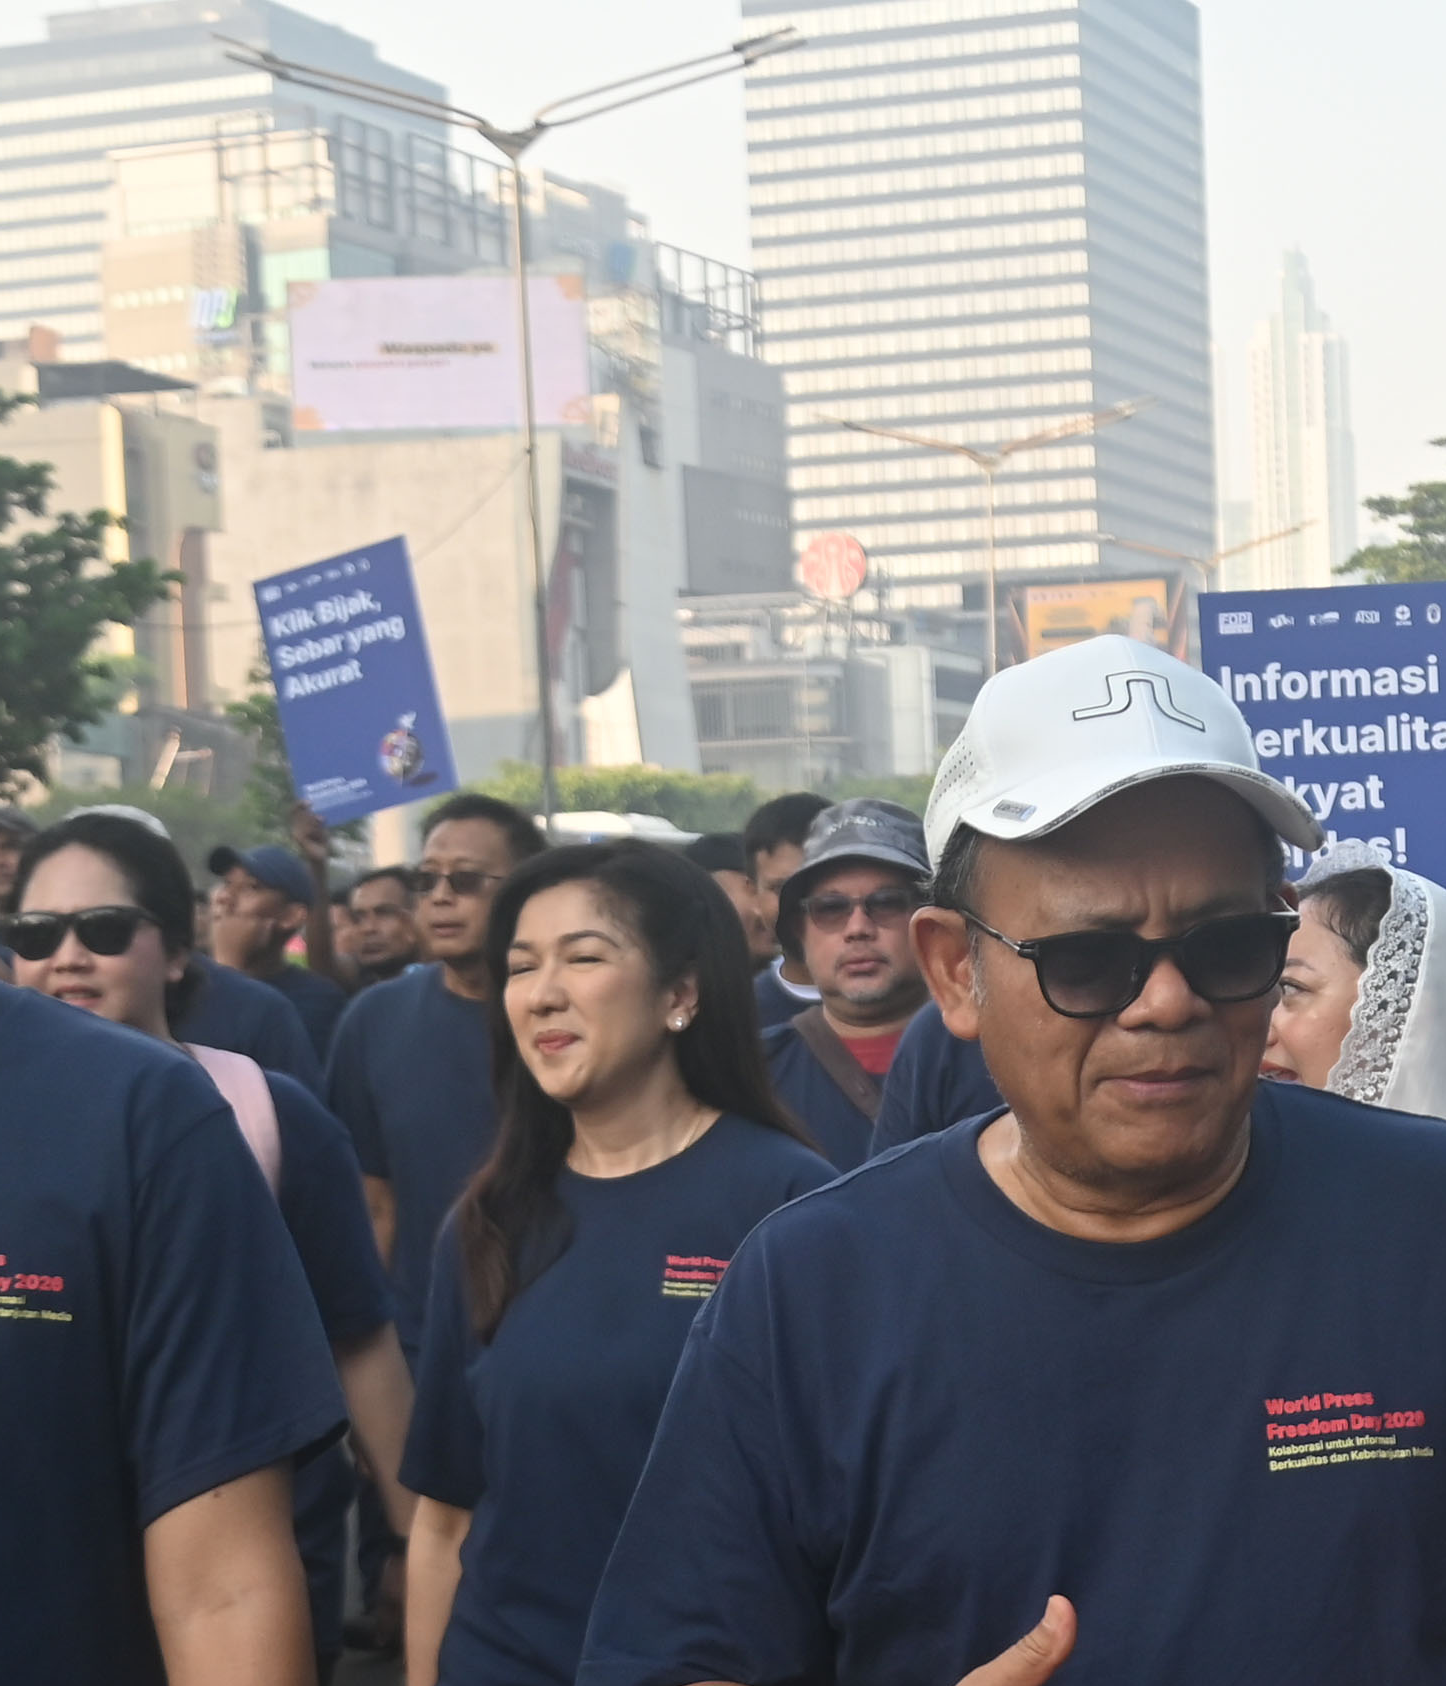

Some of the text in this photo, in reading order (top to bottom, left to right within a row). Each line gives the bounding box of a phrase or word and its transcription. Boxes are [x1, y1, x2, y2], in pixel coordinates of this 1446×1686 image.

[269, 607, 317, 638] Klik
[315, 589, 382, 623] Bijak,
[276, 615, 406, 669] Sebar yang
[285, 659, 364, 699] Akurat
[1220, 654, 1439, 702] Informasi
[1284, 774, 1386, 821] kyat
[1265, 1391, 1374, 1416] World Press
[1266, 1417, 1349, 1440] Freedom
[1350, 1413, 1383, 1432] Day
[1268, 1439, 1324, 1458] Kolaborasi
[1325, 1437, 1355, 1450] untuk
[1269, 1454, 1329, 1472] Berkualitas
[1330, 1453, 1350, 1464] dan
